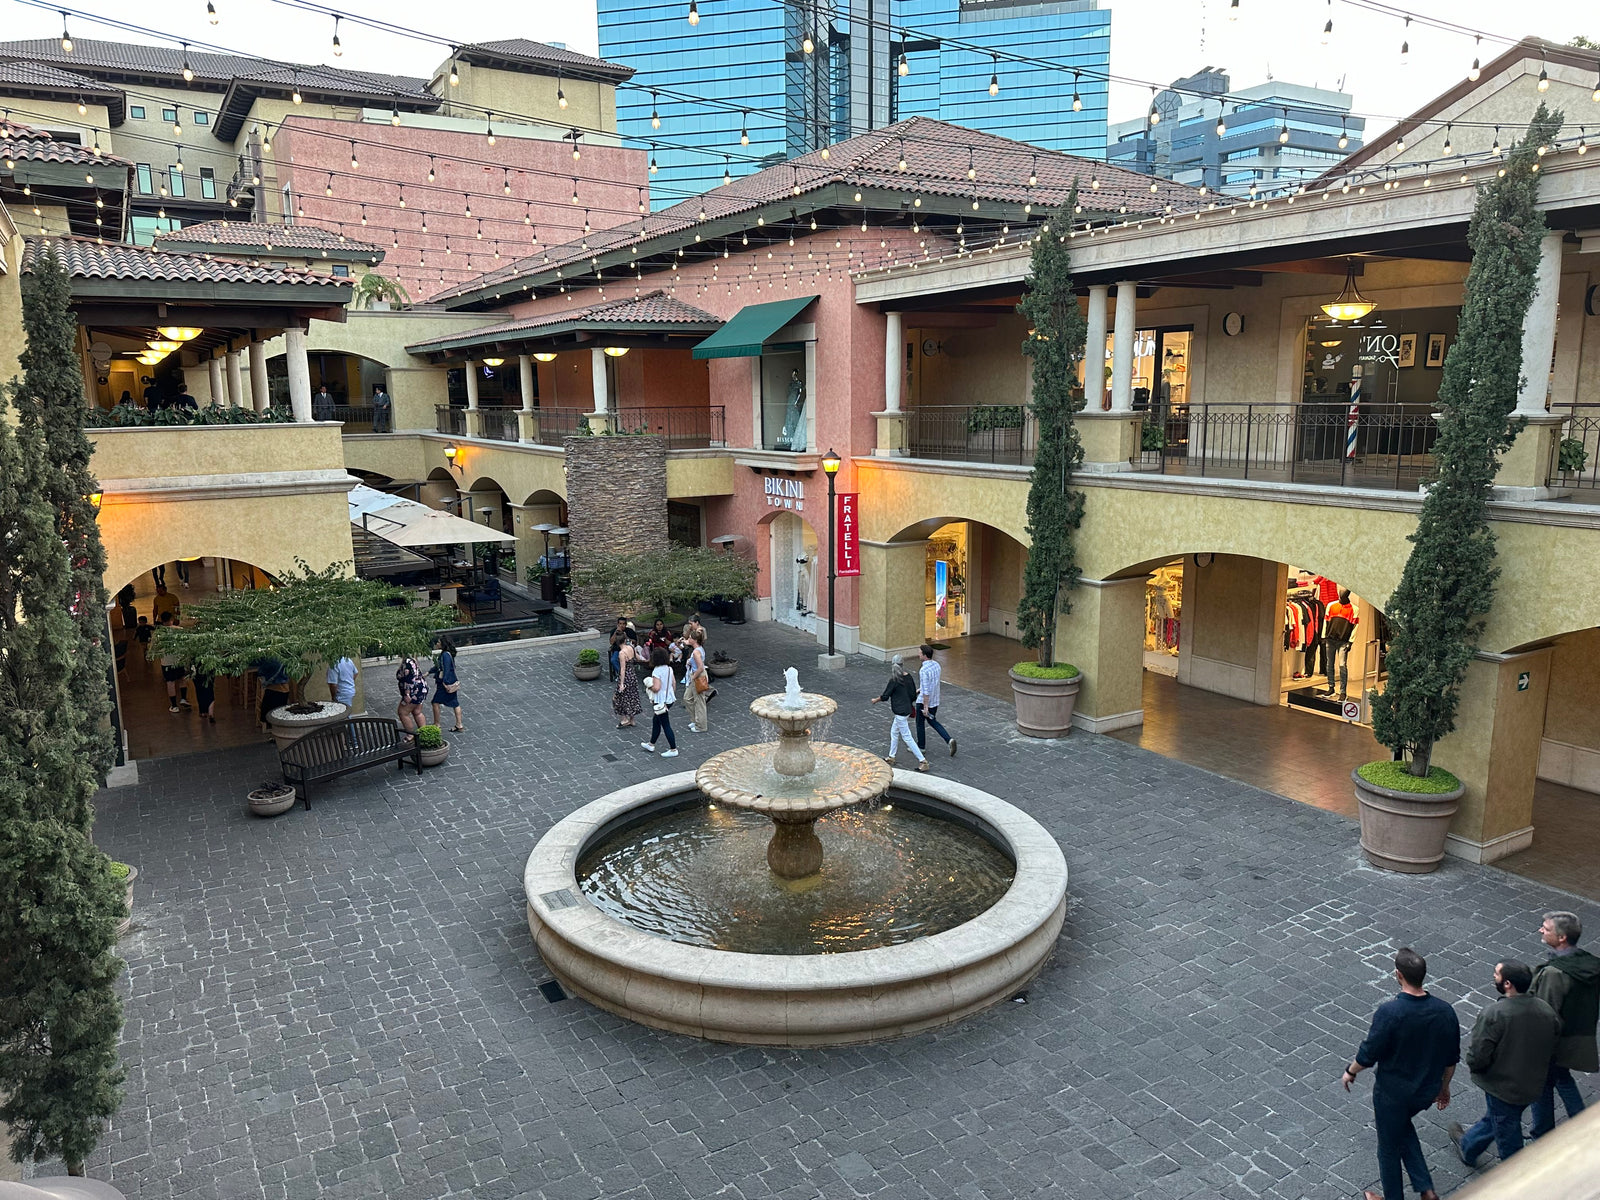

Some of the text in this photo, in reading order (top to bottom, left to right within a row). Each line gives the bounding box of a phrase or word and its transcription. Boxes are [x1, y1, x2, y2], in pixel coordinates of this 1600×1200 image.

[764, 477, 804, 499] BIKINI
[766, 496, 803, 511] TOWN
[843, 496, 852, 568] FRATELLI
